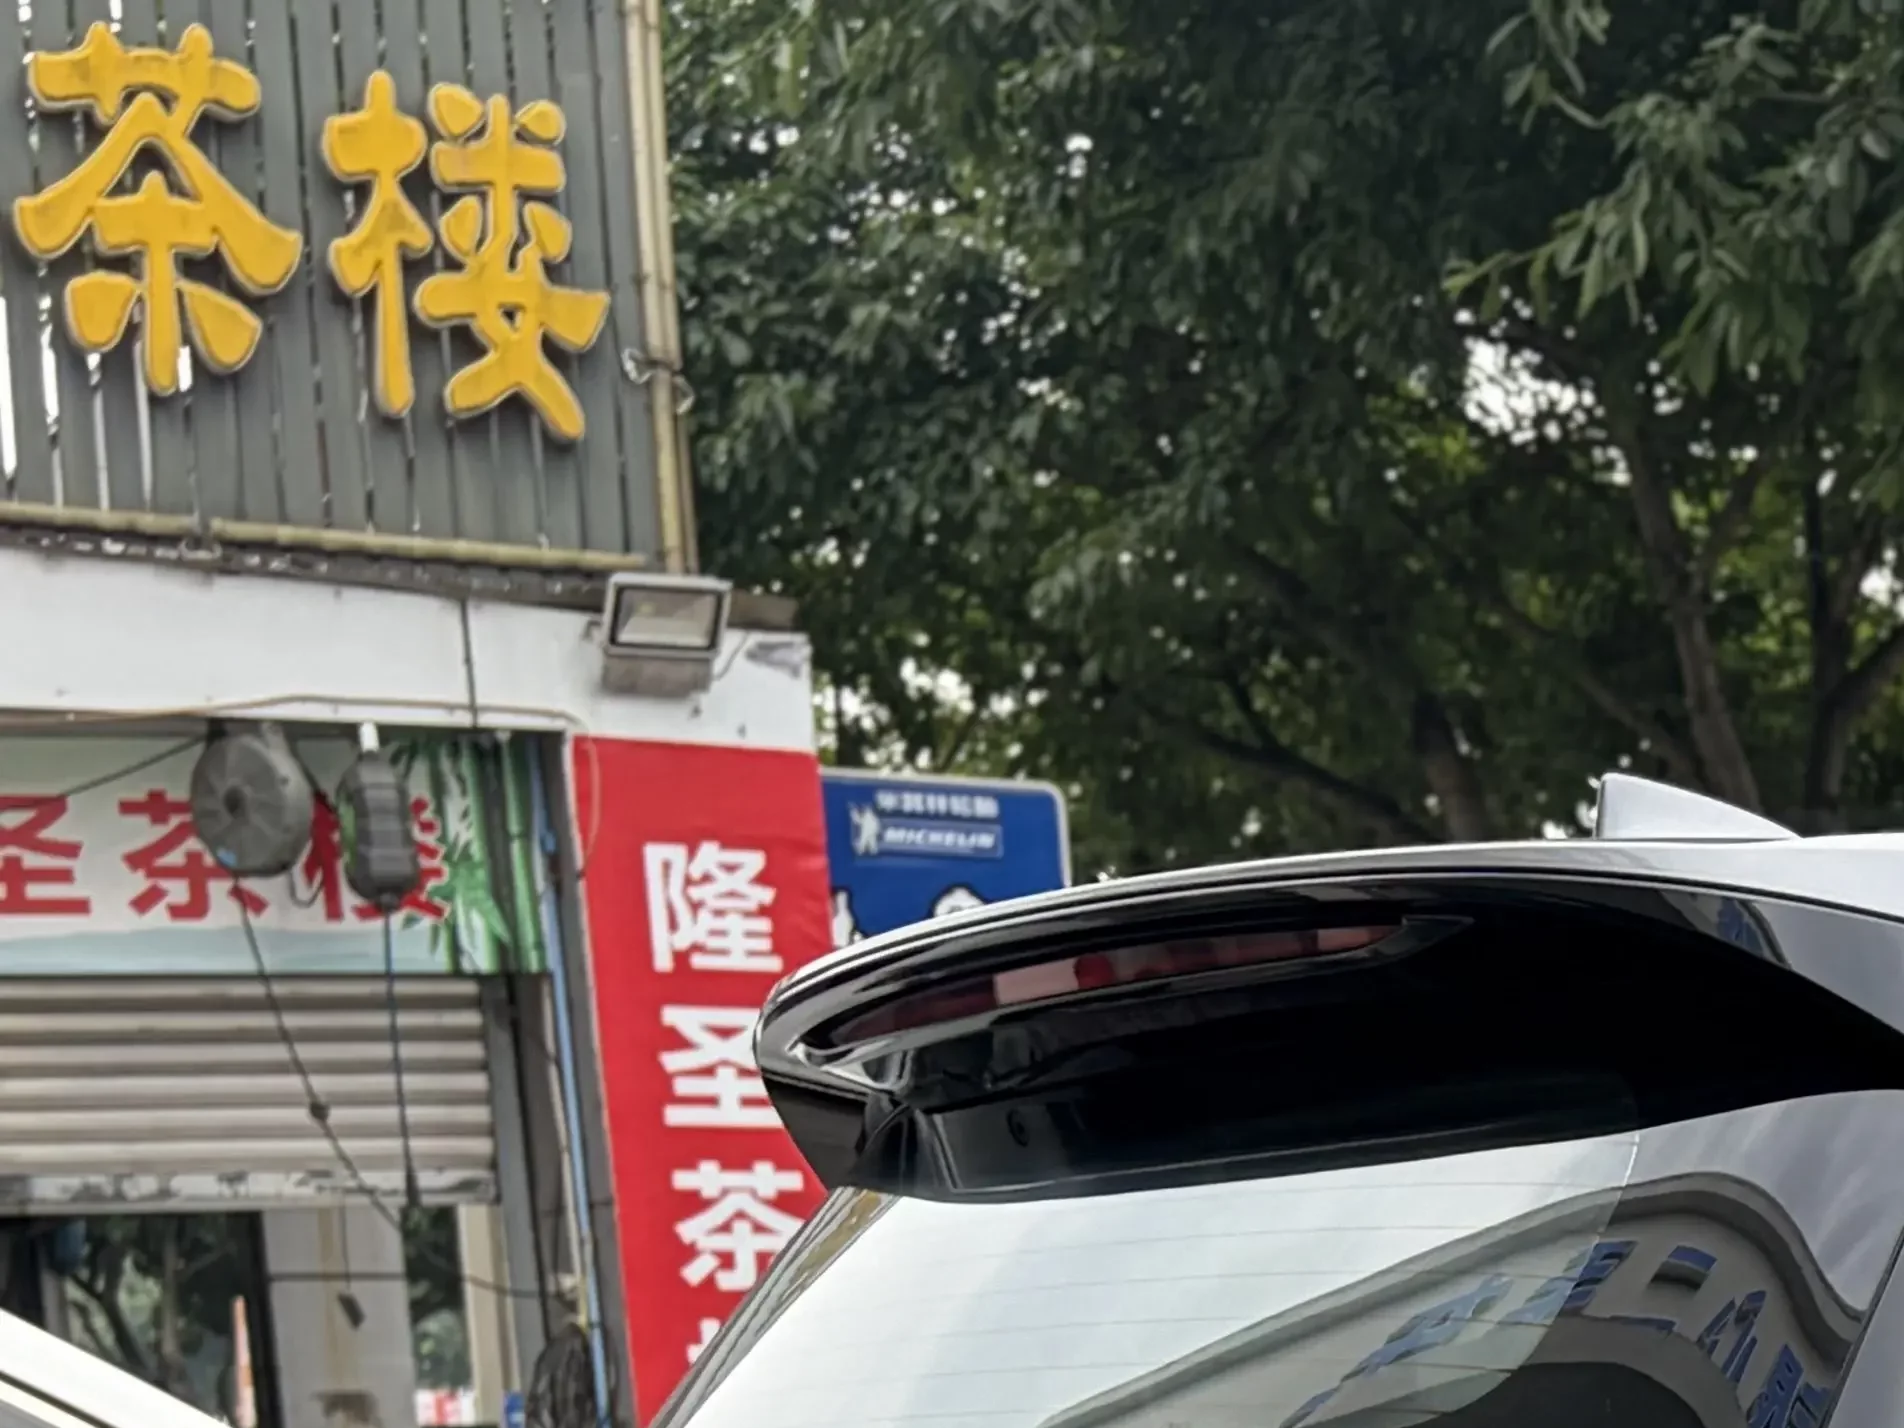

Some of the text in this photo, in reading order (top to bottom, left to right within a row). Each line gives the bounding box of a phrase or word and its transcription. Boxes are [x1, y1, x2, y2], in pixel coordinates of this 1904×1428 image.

[12, 21, 610, 443] 茶楼
[641, 840, 806, 1366] 隆圣茶
